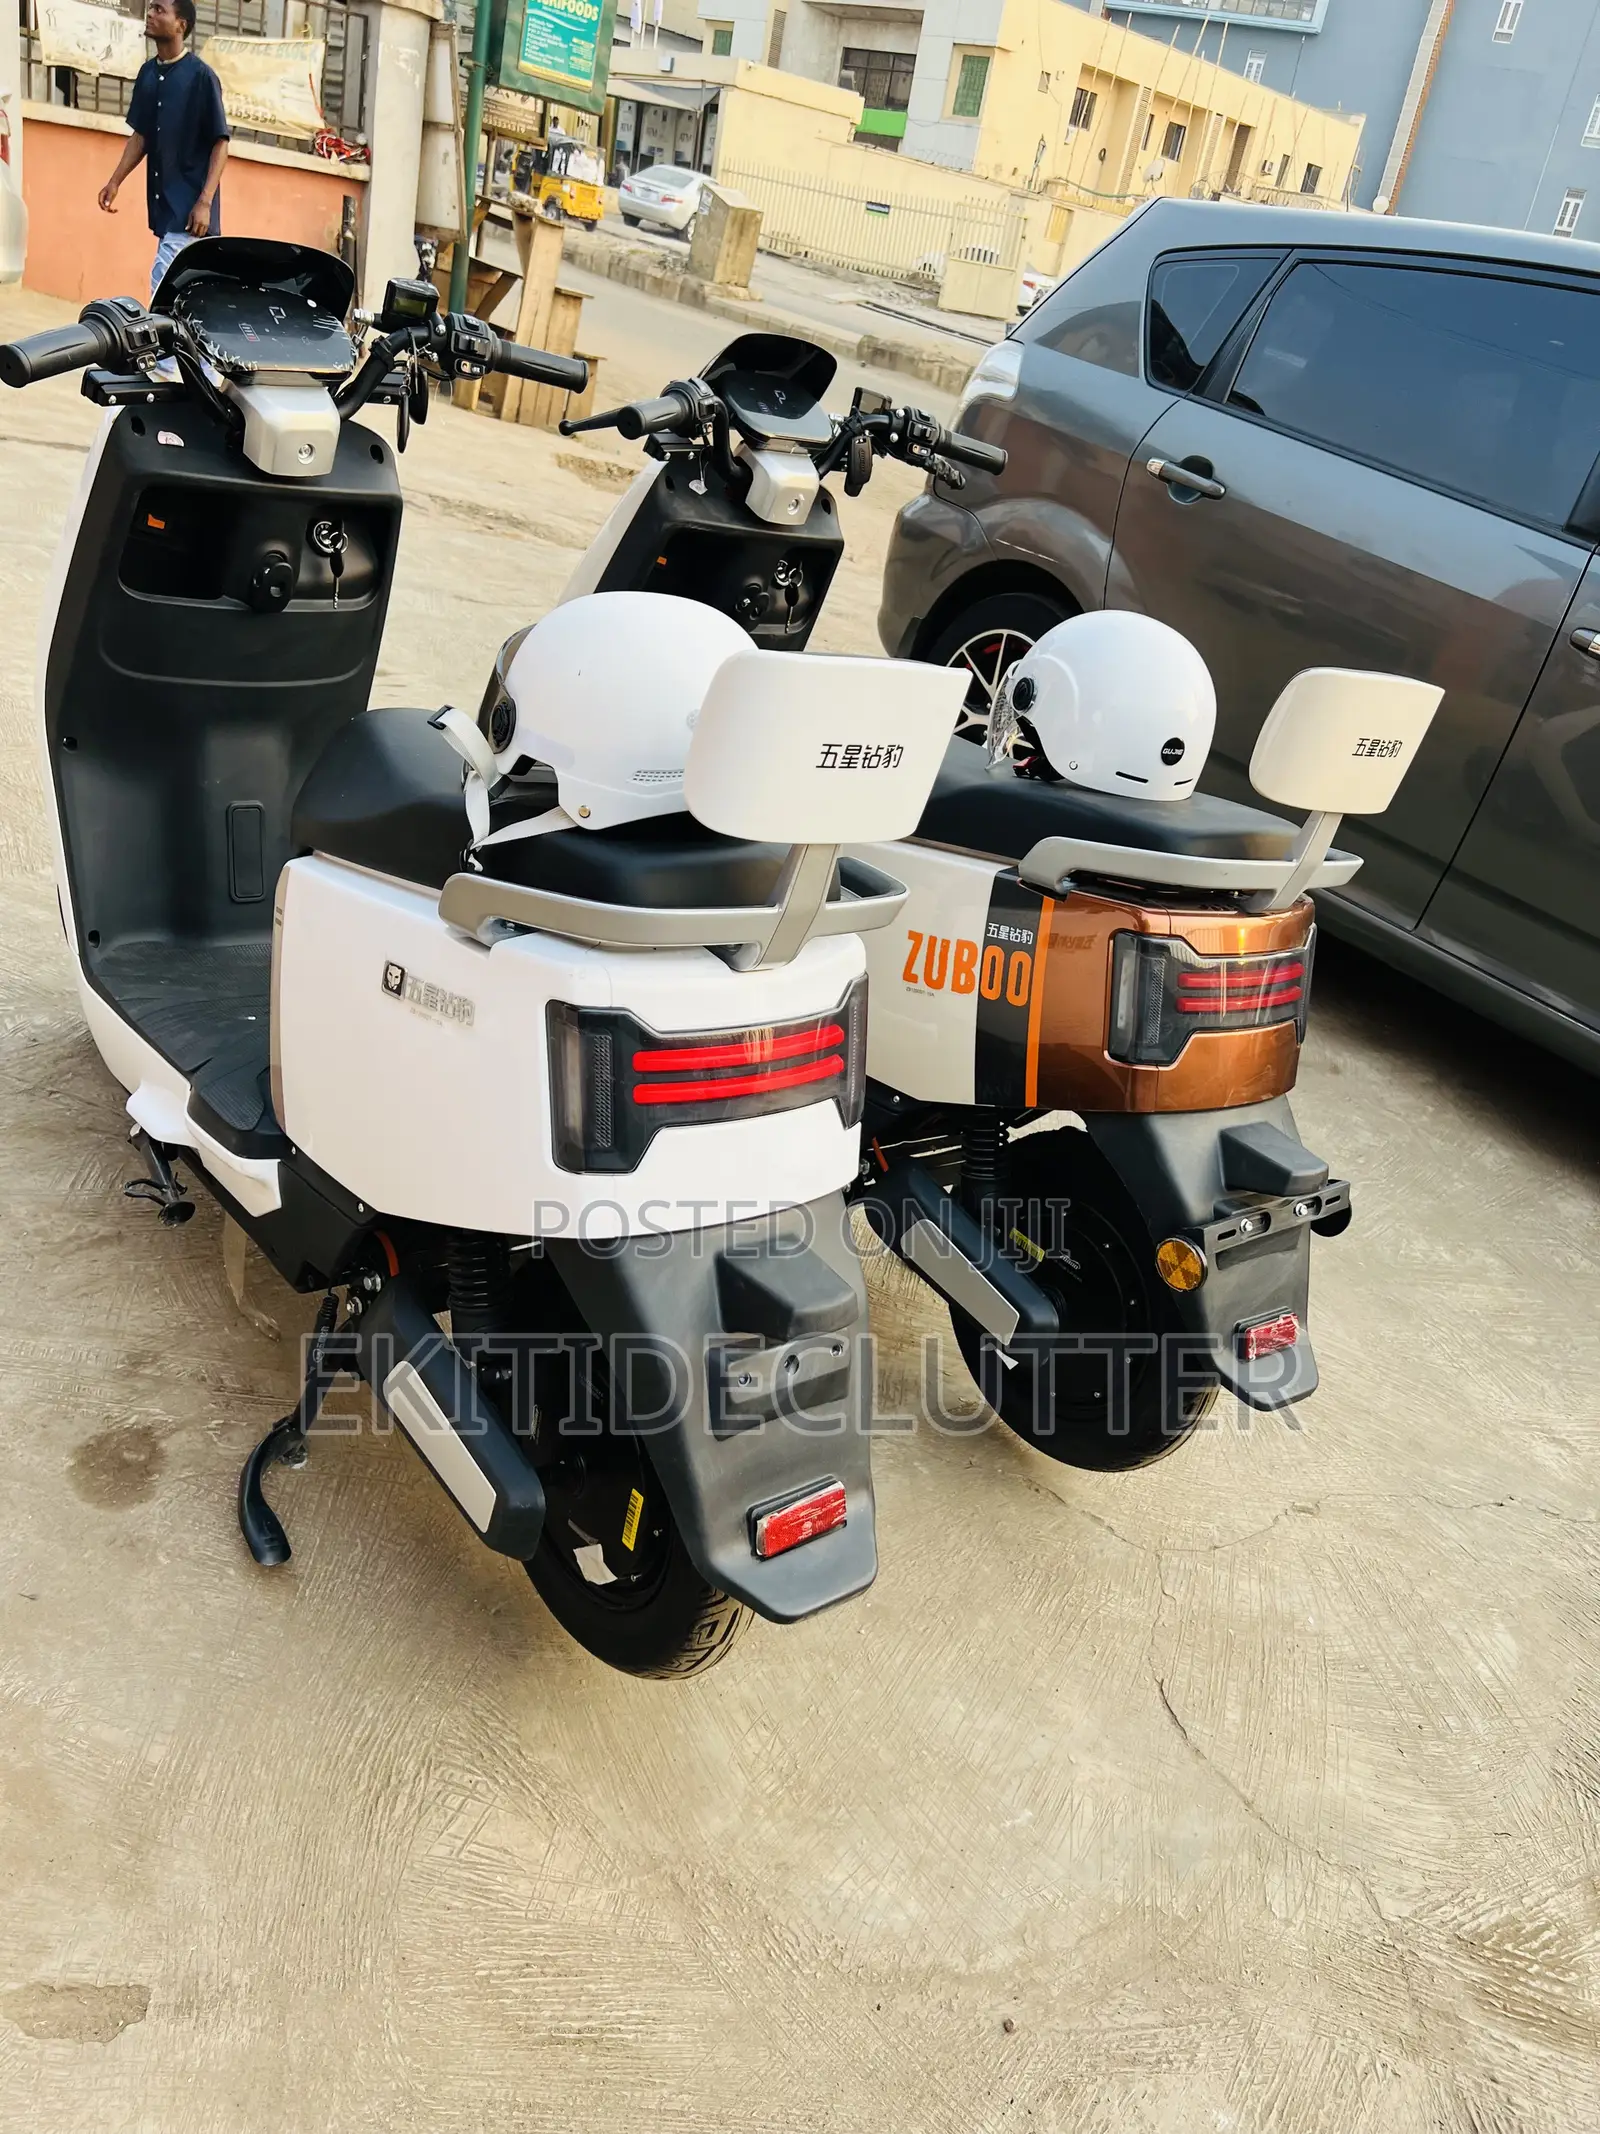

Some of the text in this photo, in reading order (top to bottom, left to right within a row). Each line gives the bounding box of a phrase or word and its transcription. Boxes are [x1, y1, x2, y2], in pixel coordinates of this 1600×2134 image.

[815, 743, 905, 769] 五星钻豹
[1352, 737, 1404, 758] 五星钻豹
[986, 922, 1034, 945] 五星钻豹
[902, 930, 1032, 1007] ZUBOO
